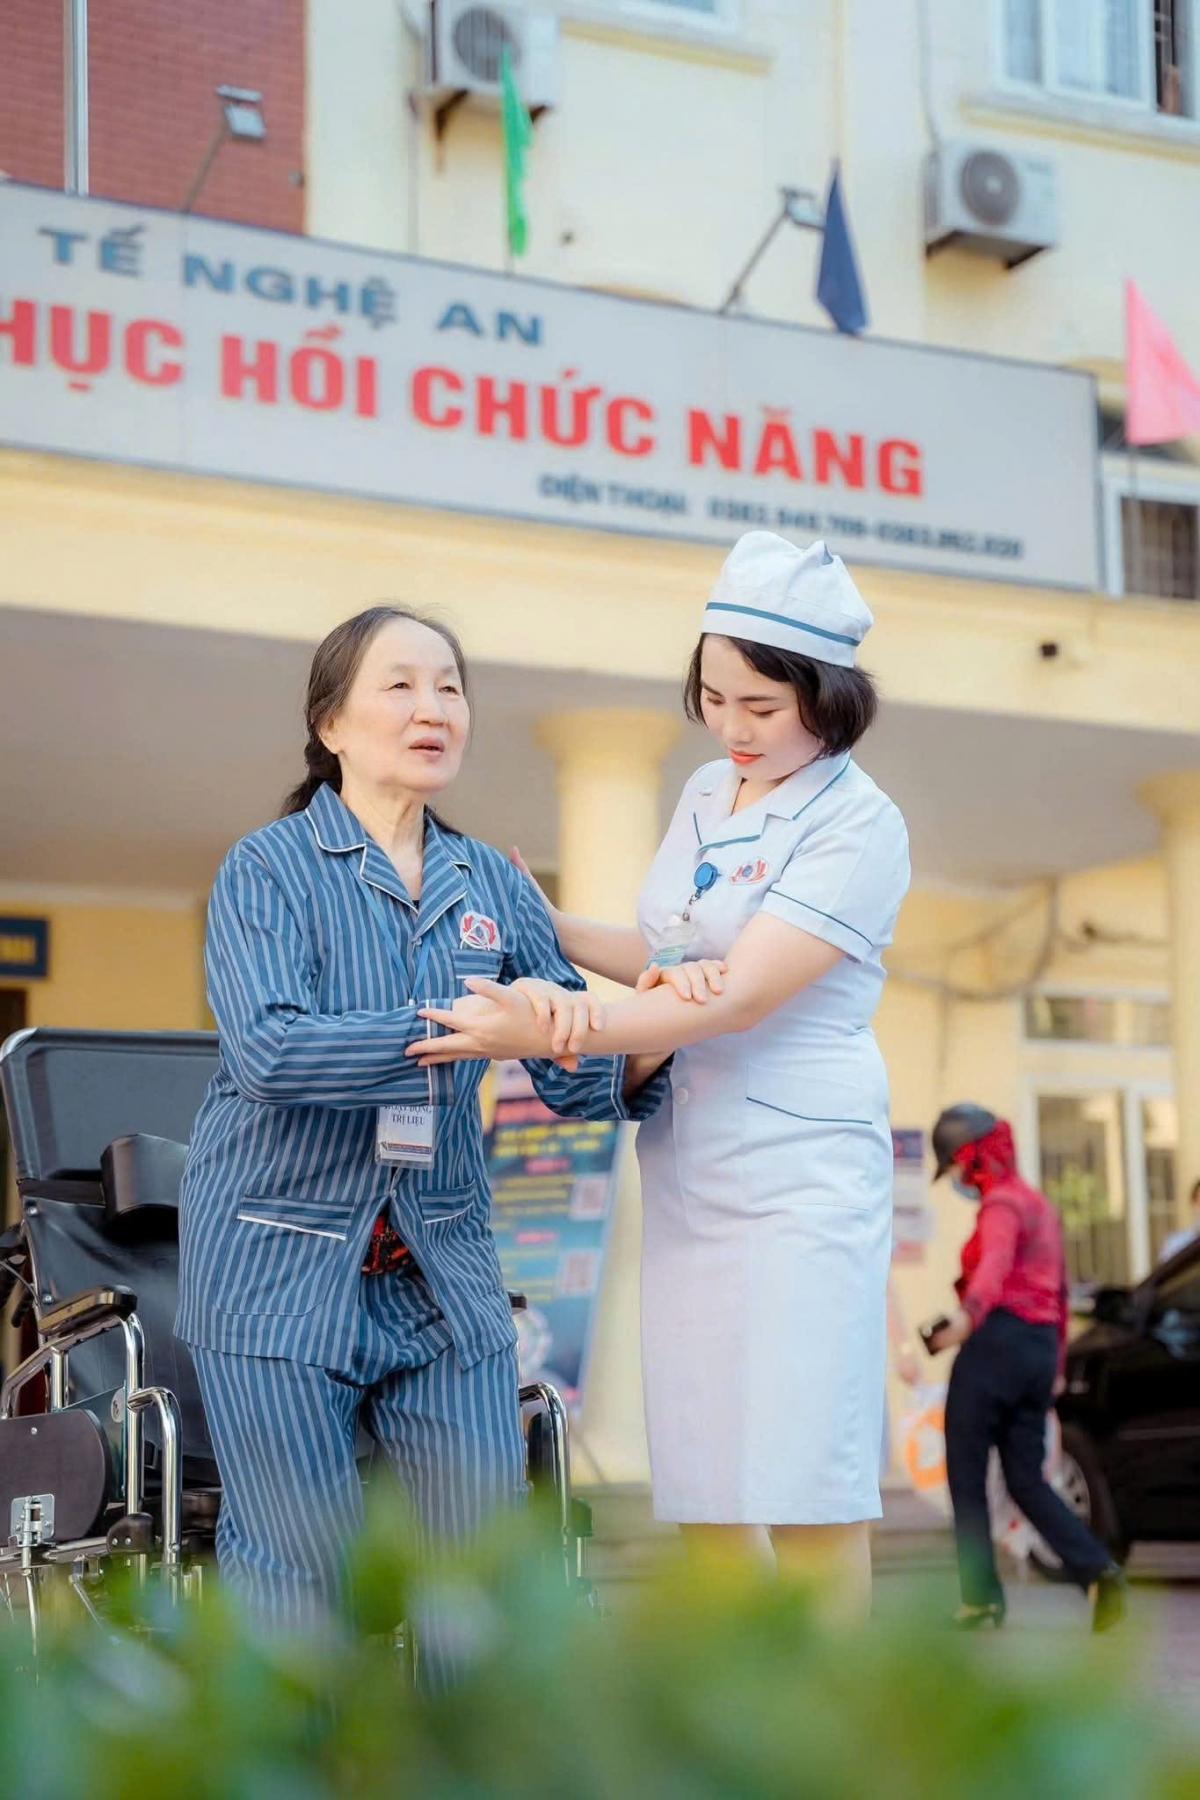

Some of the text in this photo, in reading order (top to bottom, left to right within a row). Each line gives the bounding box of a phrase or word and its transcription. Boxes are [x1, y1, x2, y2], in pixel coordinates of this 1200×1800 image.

[38, 224, 543, 347] TẾ NGHỆ AN
[410, 364, 656, 459] CHỨC
[687, 403, 922, 498] NĂNG
